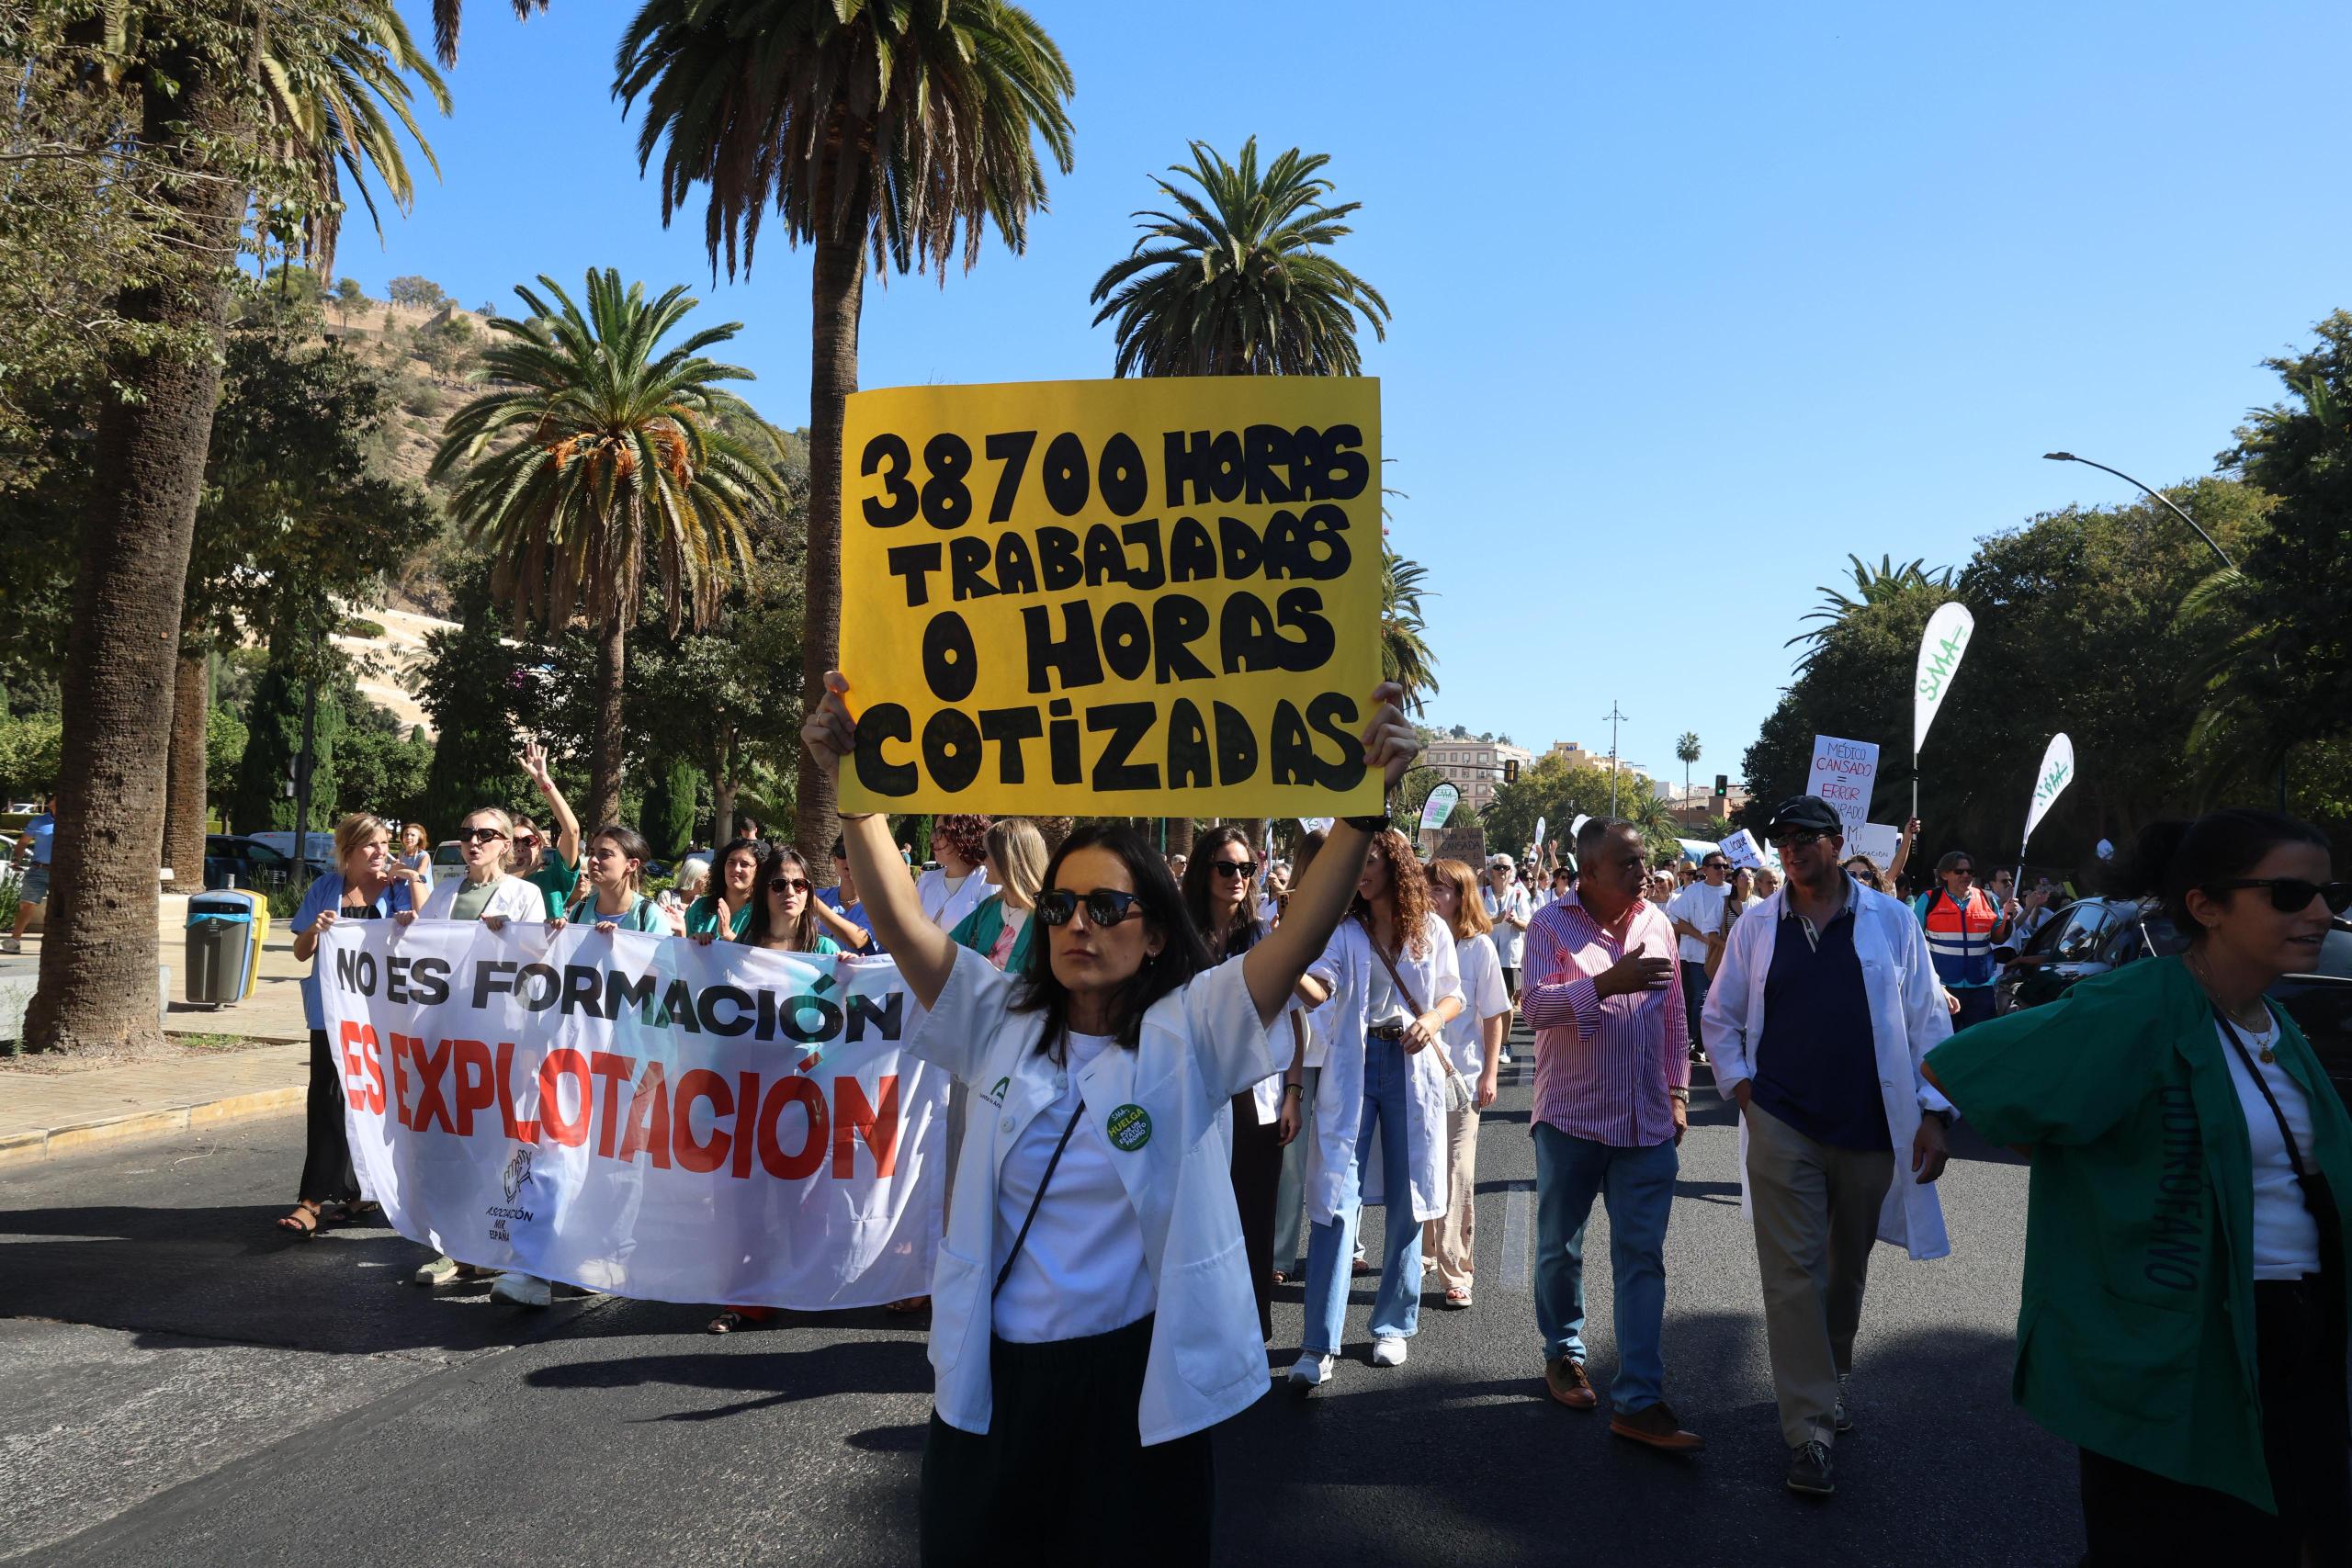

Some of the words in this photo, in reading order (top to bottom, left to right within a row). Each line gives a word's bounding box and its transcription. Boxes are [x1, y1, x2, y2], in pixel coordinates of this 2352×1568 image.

[860, 431, 1148, 530] 38700
[1163, 423, 1369, 508] HORAS
[888, 503, 1351, 607] TRABAJADAS
[1021, 587, 1336, 694] HORAS
[1827, 741, 1867, 761] MÉDICO
[1816, 757, 1872, 777] CANSADO
[1822, 783, 1860, 800] ERROR
[337, 948, 377, 998] NO
[386, 955, 451, 1006] ES
[471, 960, 904, 1044] FORMACIÓN
[340, 1020, 387, 1116] ES
[390, 1032, 899, 1181] EXPLOTACIÓN
[1108, 1108, 1145, 1137] HUELGA
[1119, 1122, 1147, 1145] ESTATUTO
[1120, 1127, 1131, 1137] POR
[1125, 1130, 1146, 1145] PROPIO
[489, 1229, 510, 1243] ESPAÑA
